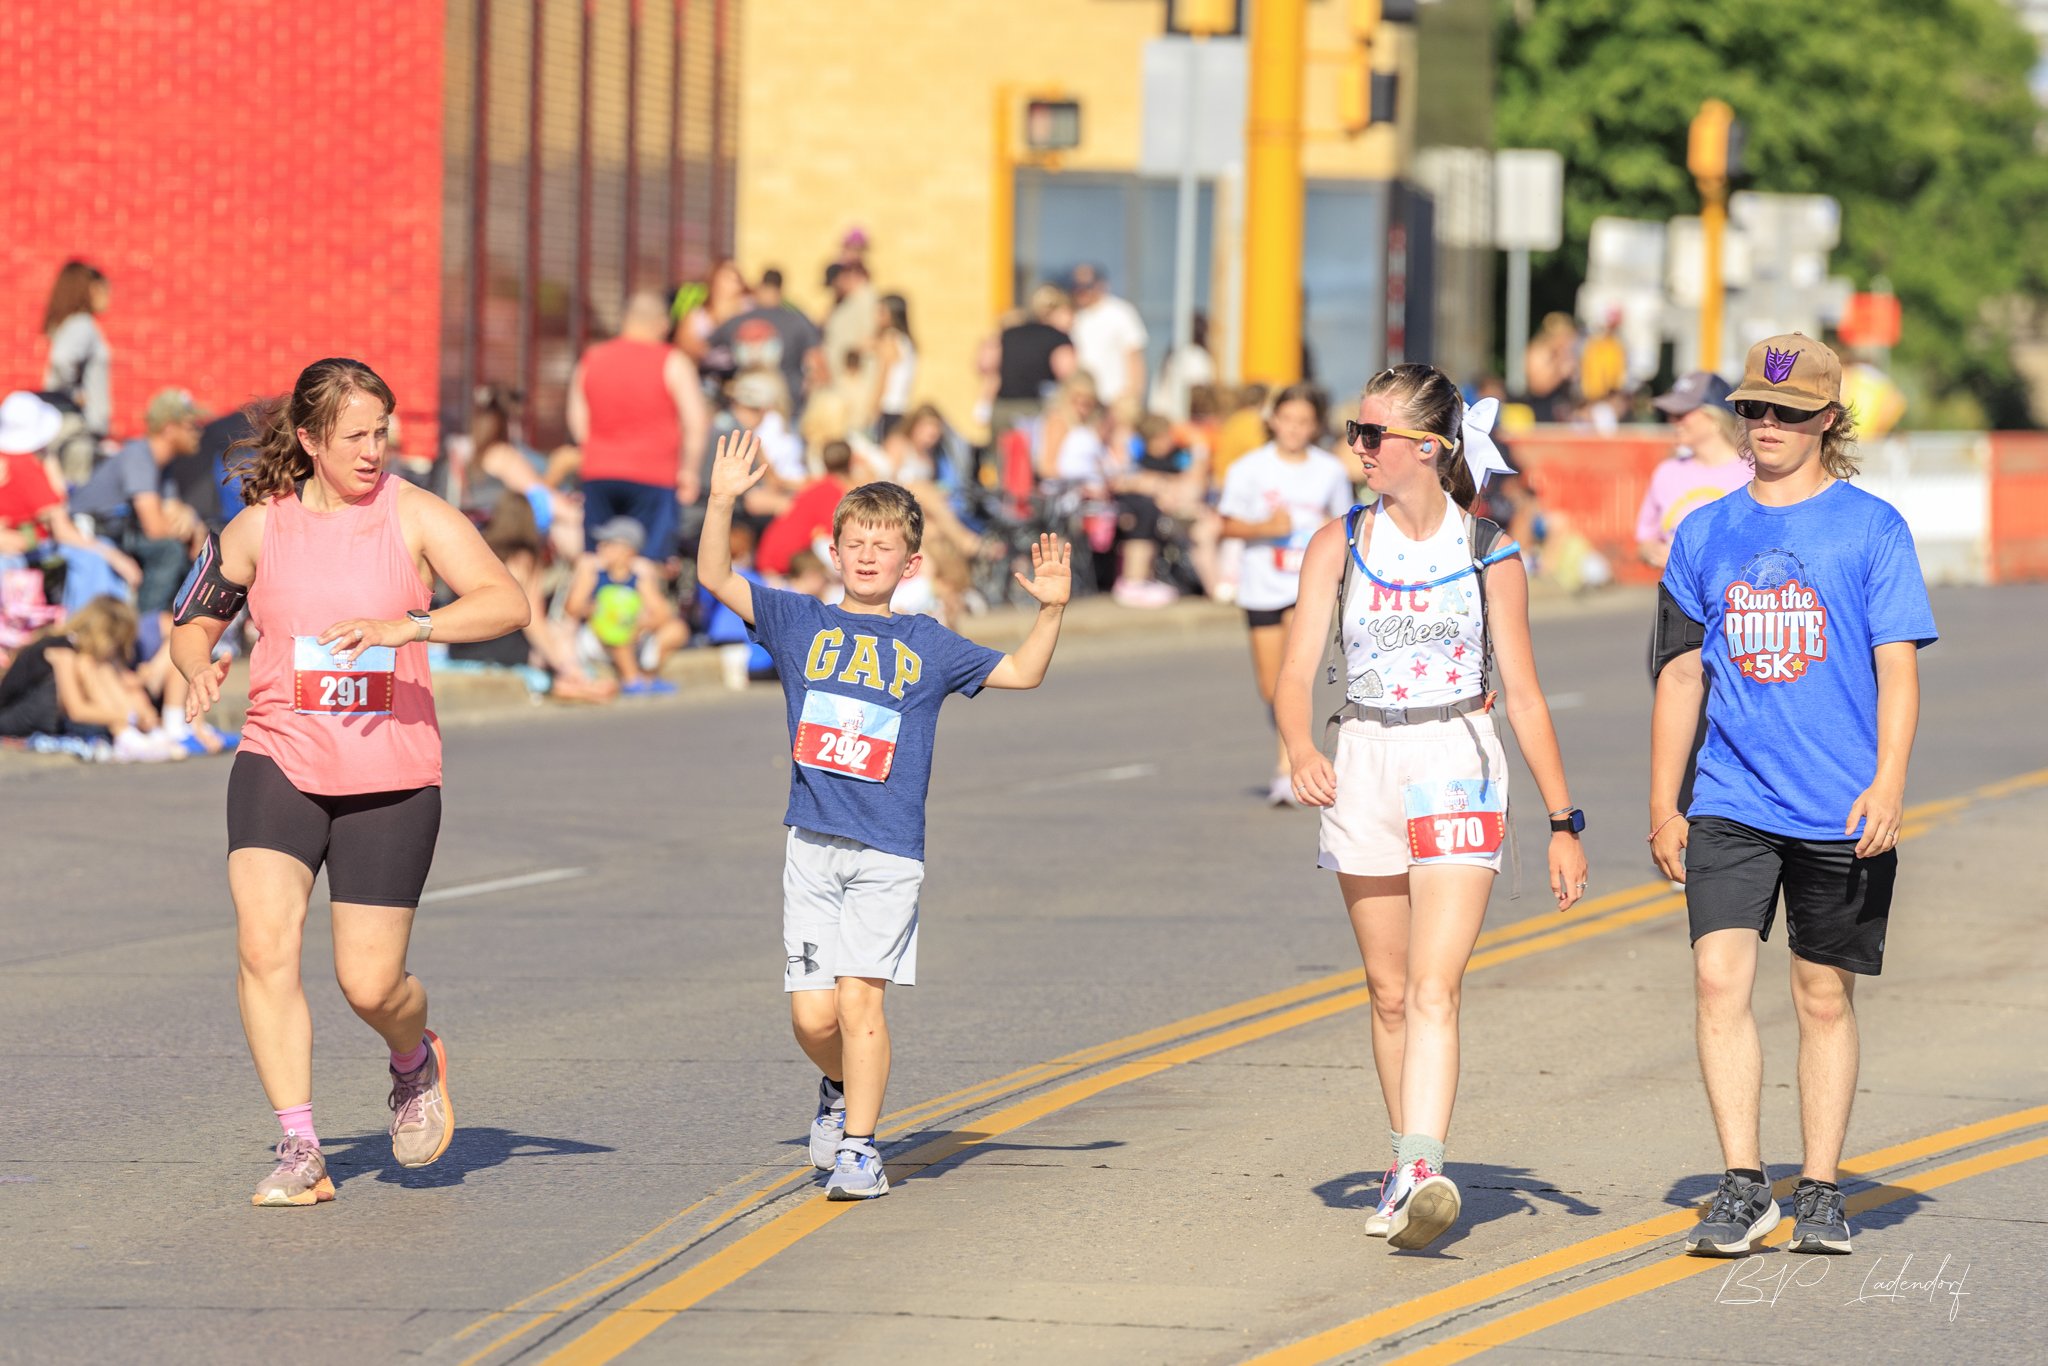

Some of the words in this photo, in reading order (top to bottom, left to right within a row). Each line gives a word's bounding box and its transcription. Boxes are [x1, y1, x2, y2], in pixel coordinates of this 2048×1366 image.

[1728, 585, 1779, 610] Run
[1781, 583, 1814, 610] the
[1367, 615, 1460, 652] Cheer
[1725, 610, 1824, 659] ROUTE
[804, 627, 923, 701] GAP
[1754, 653, 1795, 679] 5K
[319, 675, 368, 706] 291
[816, 732, 871, 770] 292
[1433, 816, 1485, 851] 370
